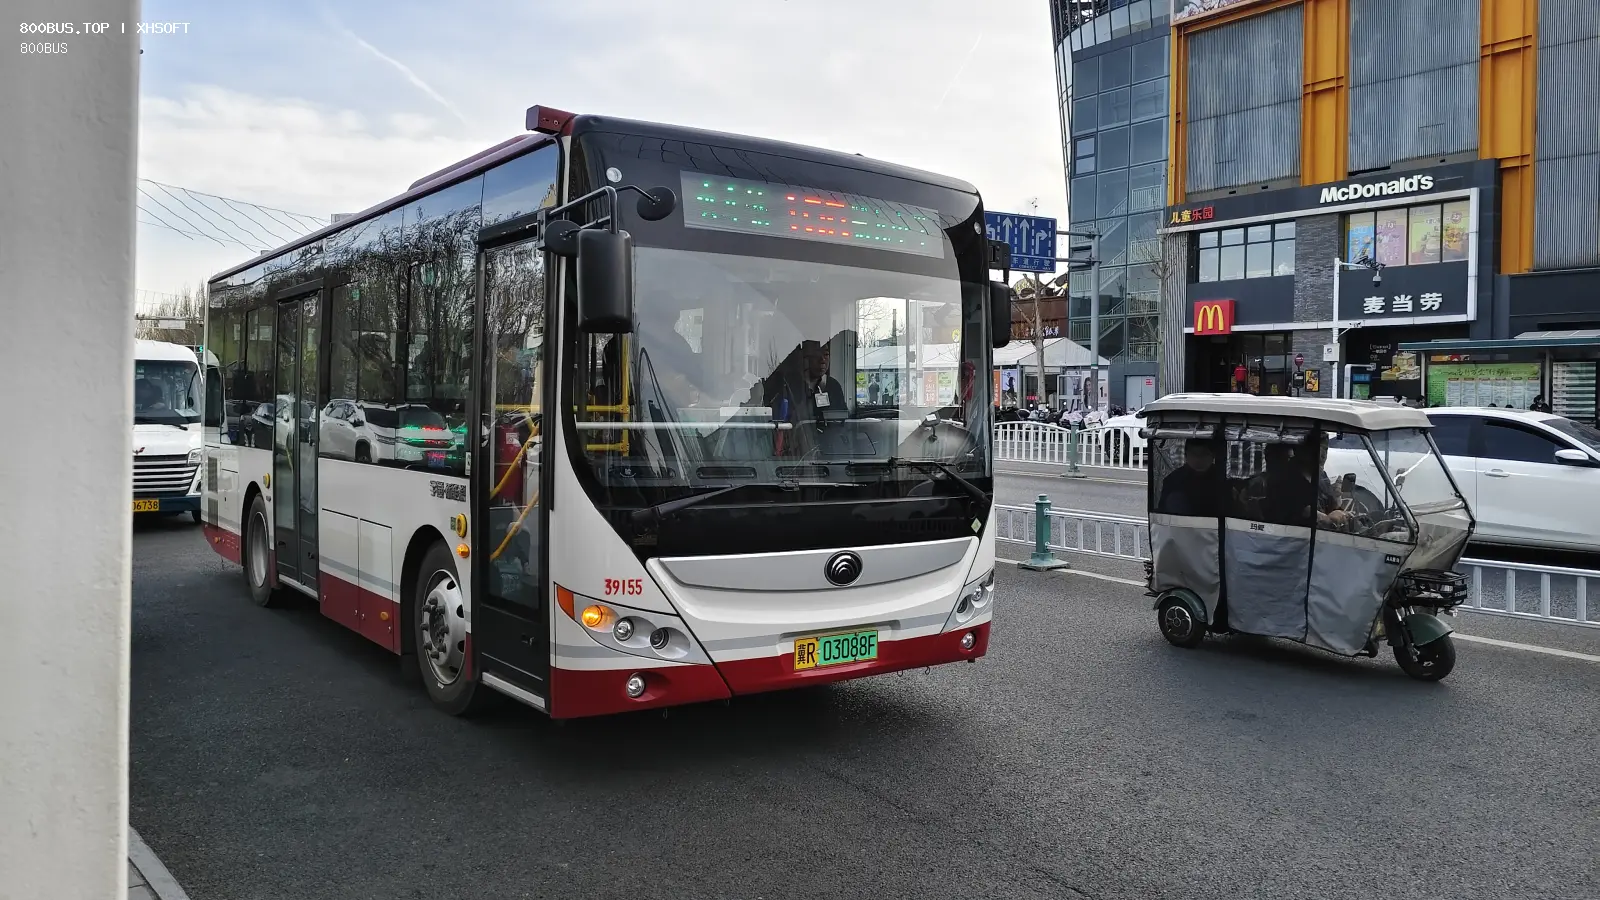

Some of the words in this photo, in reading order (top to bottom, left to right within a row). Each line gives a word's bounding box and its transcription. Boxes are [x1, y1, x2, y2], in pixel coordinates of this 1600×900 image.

[1319, 174, 1434, 204] McDonald's
[1170, 206, 1214, 224] 儿童乐园
[1363, 292, 1443, 314] 麦当劳
[604, 578, 643, 596] 39155
